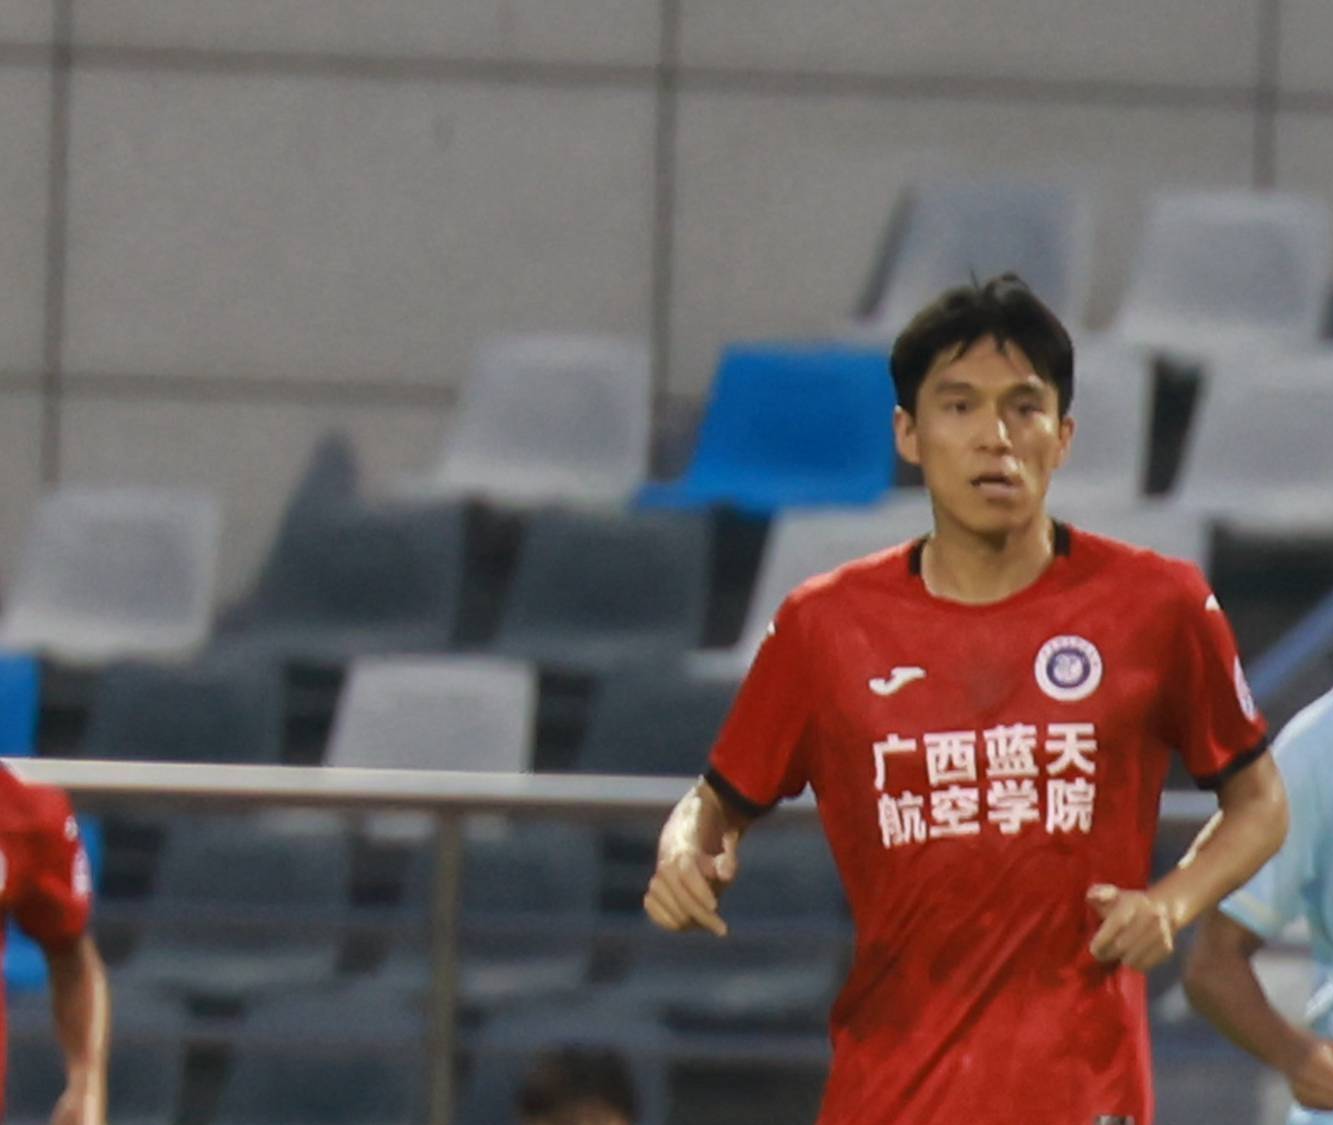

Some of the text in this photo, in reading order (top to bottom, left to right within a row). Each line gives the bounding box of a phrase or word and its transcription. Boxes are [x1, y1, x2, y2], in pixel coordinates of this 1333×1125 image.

[872, 722, 1098, 790] 广西蓝天
[877, 777, 1097, 849] 航空学院
